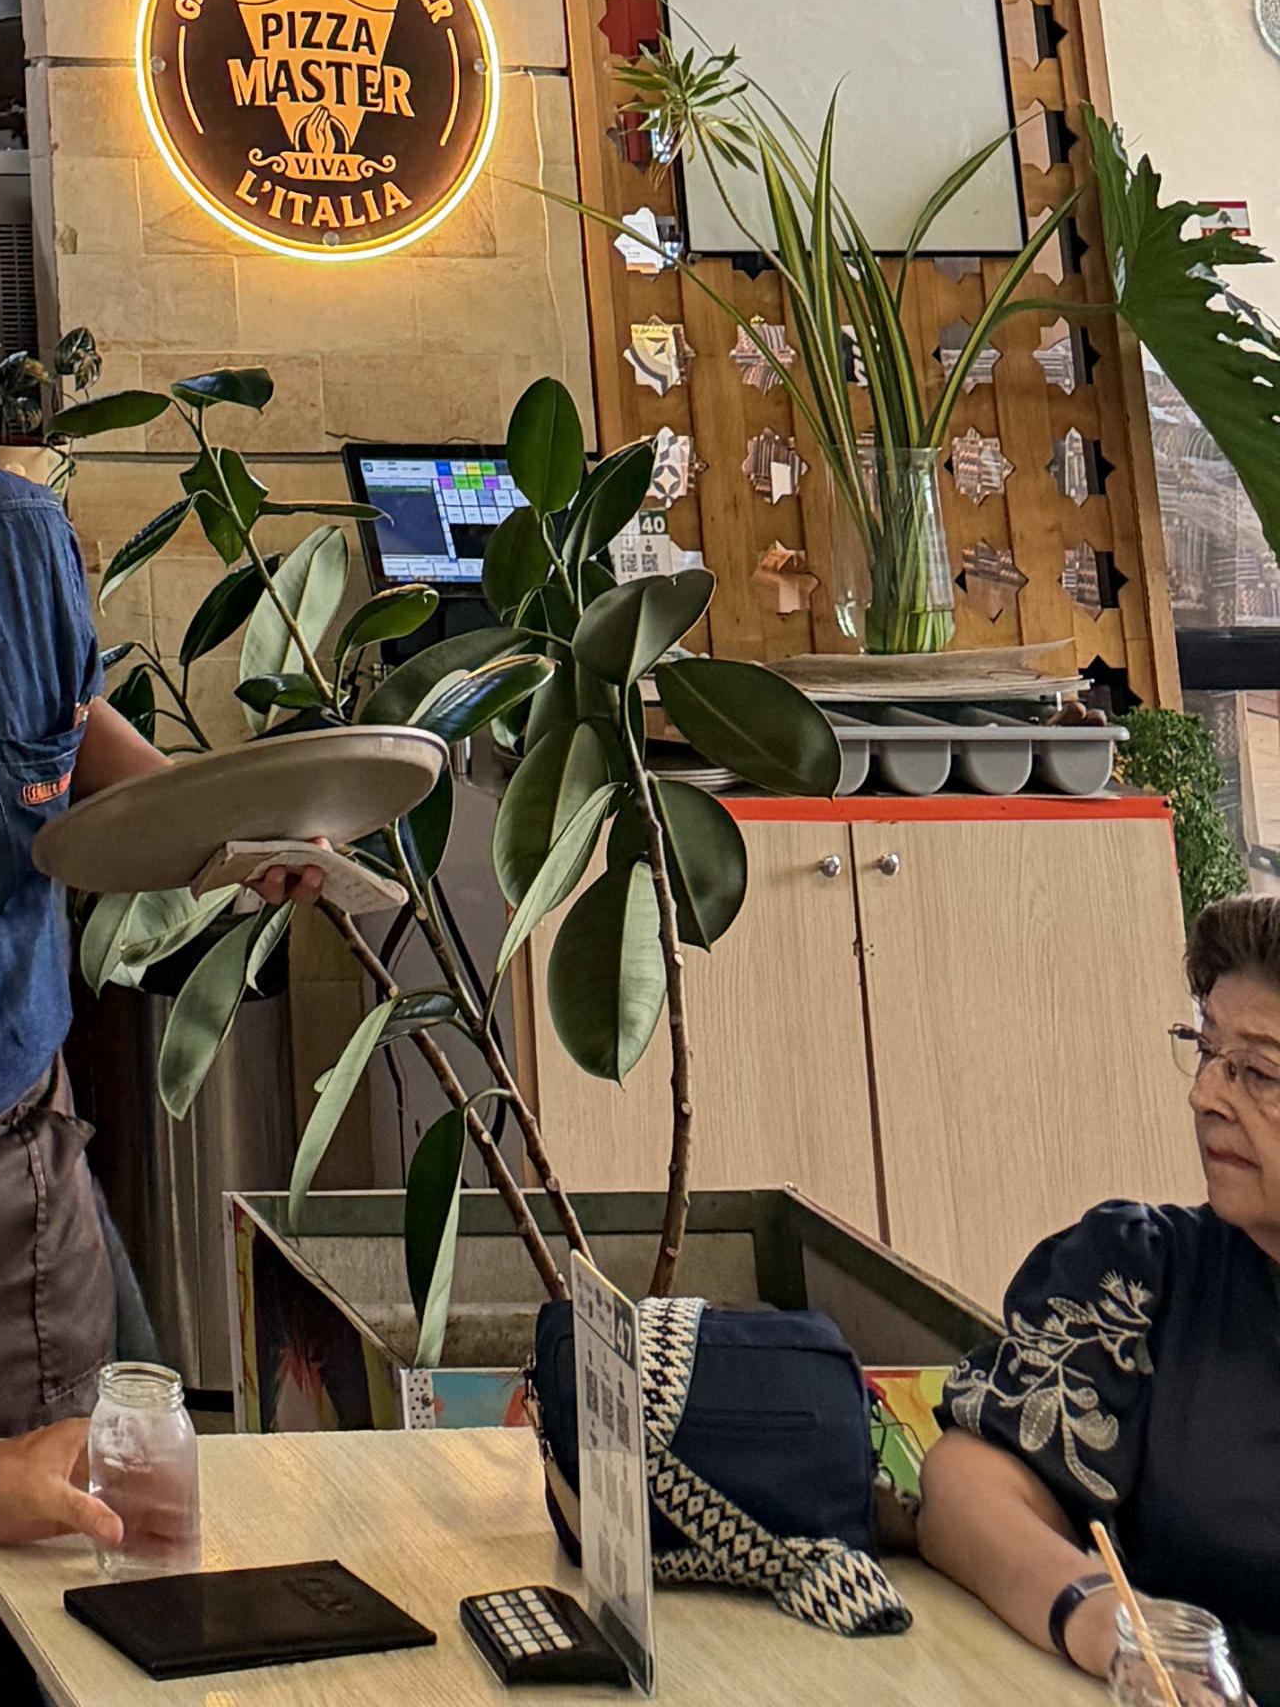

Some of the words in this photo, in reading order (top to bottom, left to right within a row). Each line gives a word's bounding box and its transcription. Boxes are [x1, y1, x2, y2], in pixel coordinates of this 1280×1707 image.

[260, 10, 377, 56] PIZZA
[227, 57, 416, 118] MASTER
[294, 156, 352, 178] VIVA
[641, 516, 666, 534] 40
[616, 1317, 632, 1361] 47
